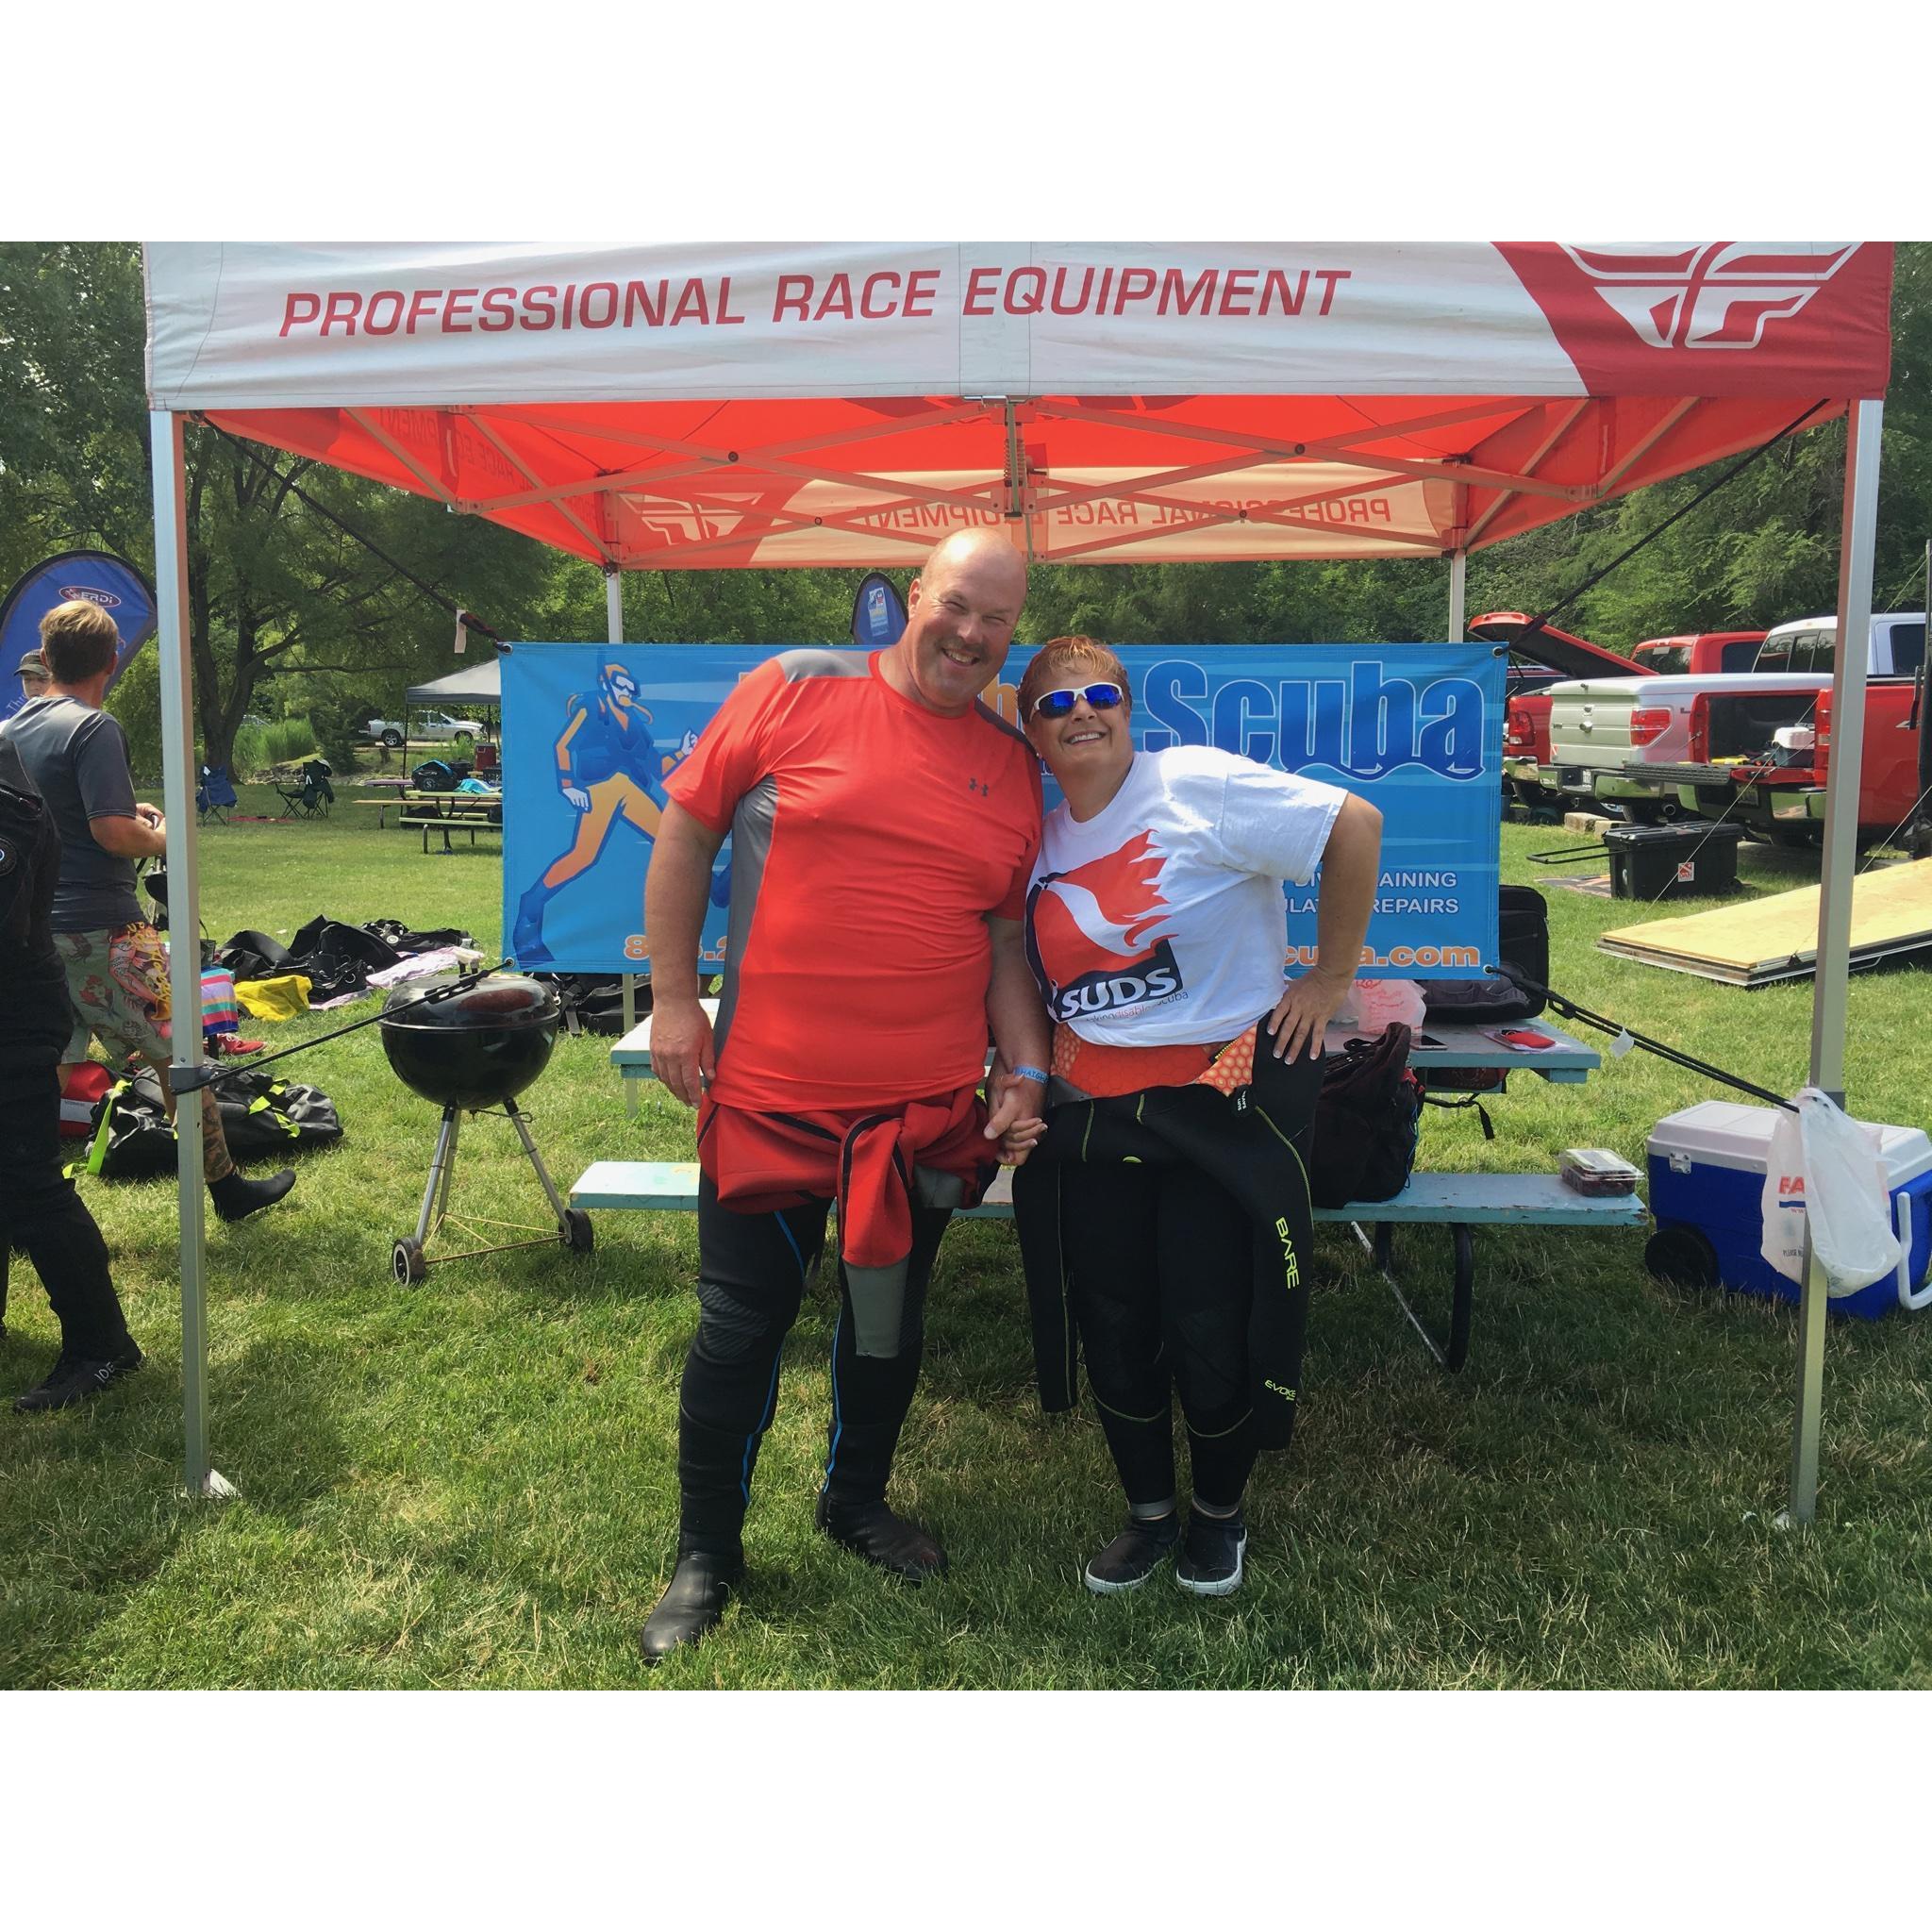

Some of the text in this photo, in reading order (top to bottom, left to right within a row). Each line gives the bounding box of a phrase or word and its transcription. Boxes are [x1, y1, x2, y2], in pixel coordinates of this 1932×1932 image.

[278, 267, 1352, 337] PROFESSIONAL RACE EQUIPMENT
[1142, 659, 1487, 782] Scuba
[1377, 872, 1457, 887] AINING
[1373, 898, 1459, 913] REPAIRS
[1283, 945, 1481, 967] cua.com
[1060, 967, 1177, 1019] SUDS
[1275, 1216, 1300, 1290] BARE
[1264, 1379, 1296, 1398] EVOKE
